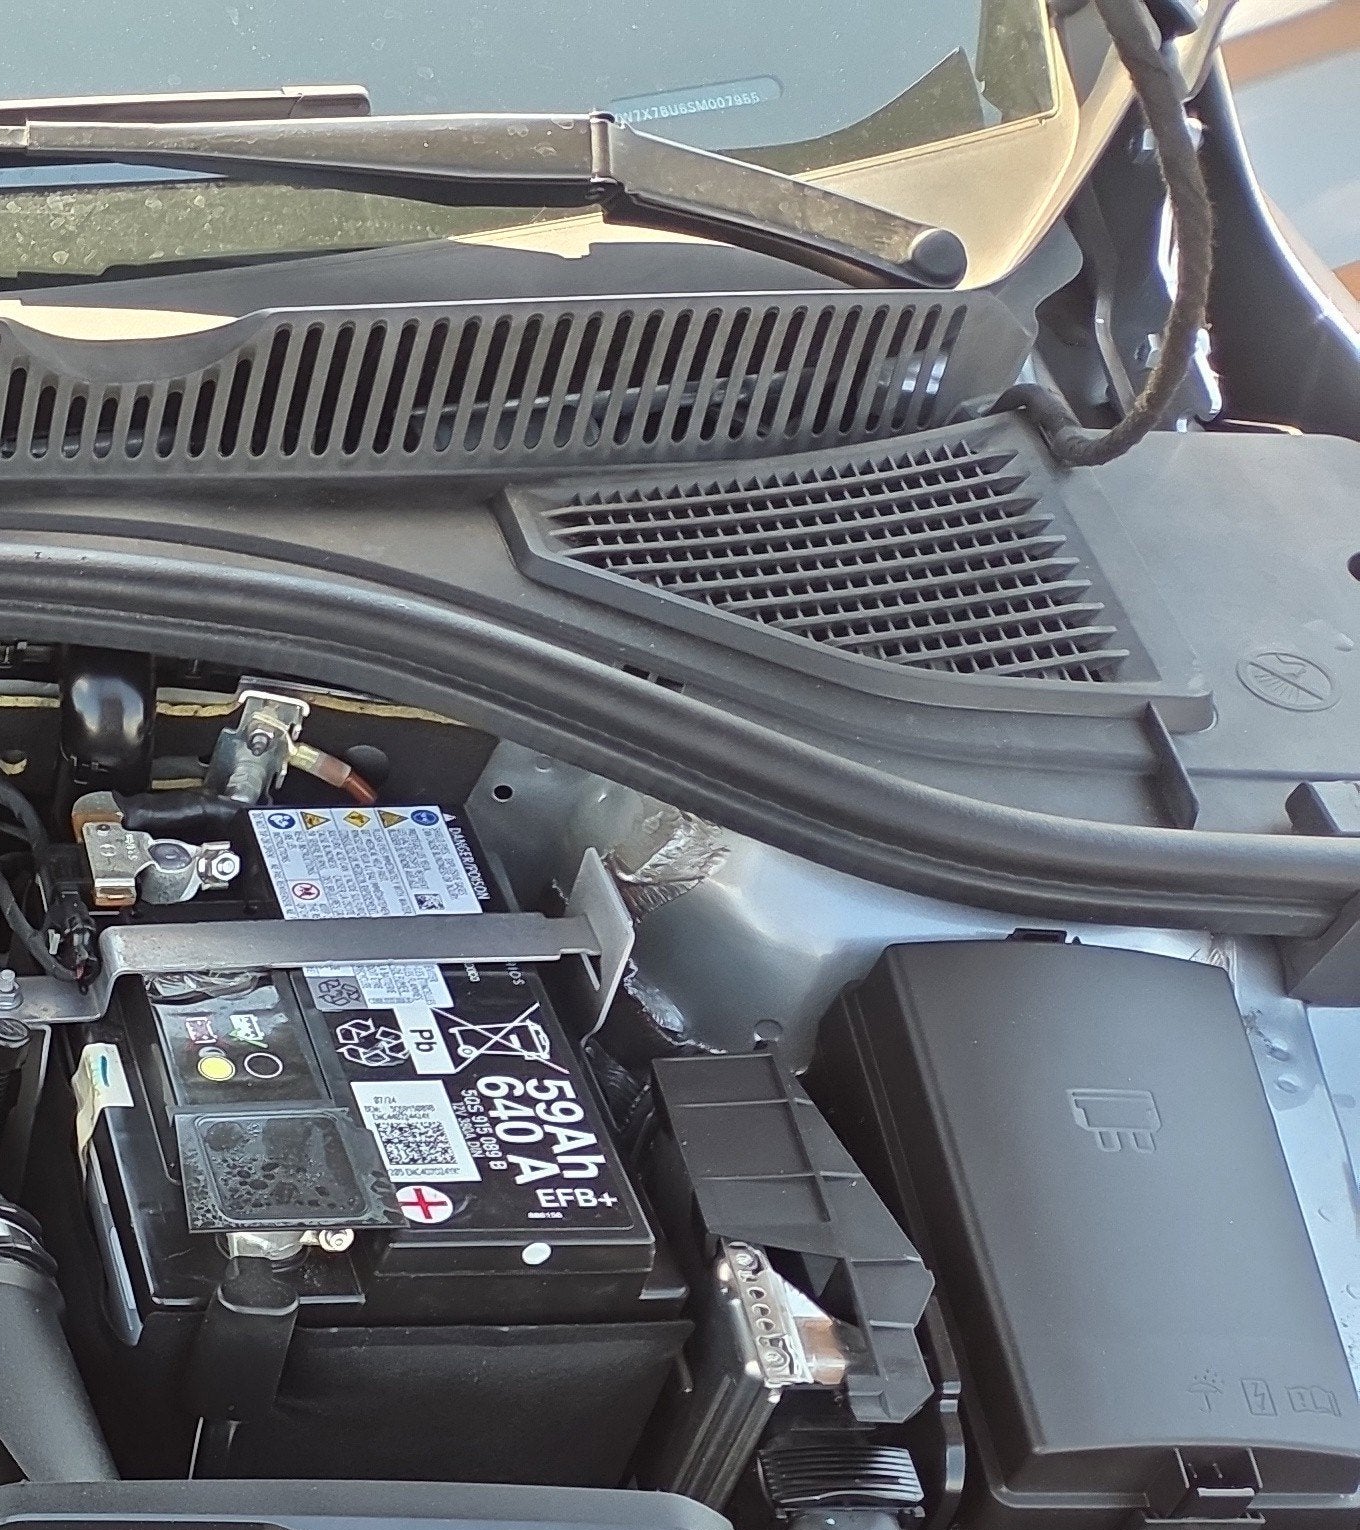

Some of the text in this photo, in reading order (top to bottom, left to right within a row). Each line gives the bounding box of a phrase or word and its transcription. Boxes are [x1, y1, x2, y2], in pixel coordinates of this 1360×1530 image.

[409, 1029, 438, 1053] Pb
[476, 1075, 544, 1144] 640
[471, 1115, 493, 1135] 915
[525, 1078, 607, 1179] 59Ah
[480, 1137, 503, 1158] 089
[506, 1154, 561, 1185] A
[535, 1188, 618, 1208] EFB+
